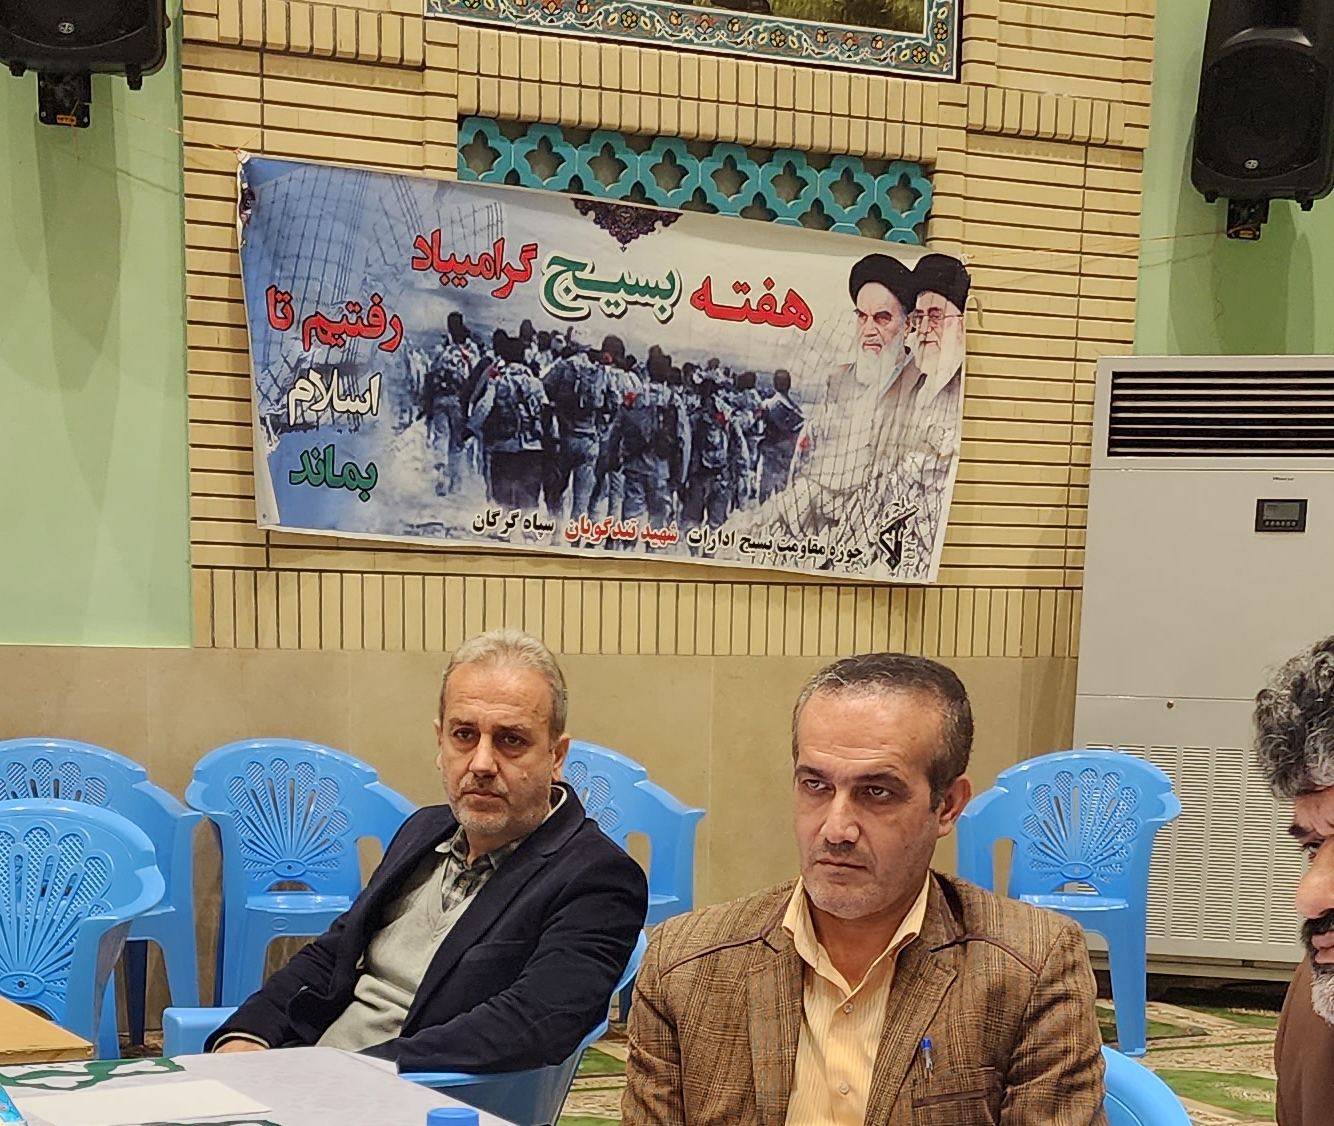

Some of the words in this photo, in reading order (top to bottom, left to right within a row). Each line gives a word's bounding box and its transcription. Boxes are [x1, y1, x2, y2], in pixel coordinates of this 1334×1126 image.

[411, 228, 538, 299] گرامیباد
[543, 251, 680, 319] بسیج
[265, 285, 295, 331] تا
[690, 276, 814, 331] هفته
[302, 292, 404, 353] رفتیم
[287, 367, 383, 427] اسلام
[288, 443, 379, 503] بماند
[471, 508, 520, 536] گرگان
[523, 512, 556, 539] سپاه
[564, 514, 637, 543] تندگویان
[640, 522, 679, 547] شهید
[687, 526, 735, 552] ادارات
[739, 536, 774, 556] بسیج
[776, 536, 827, 560] مقاومت
[829, 541, 863, 564] حوزه
